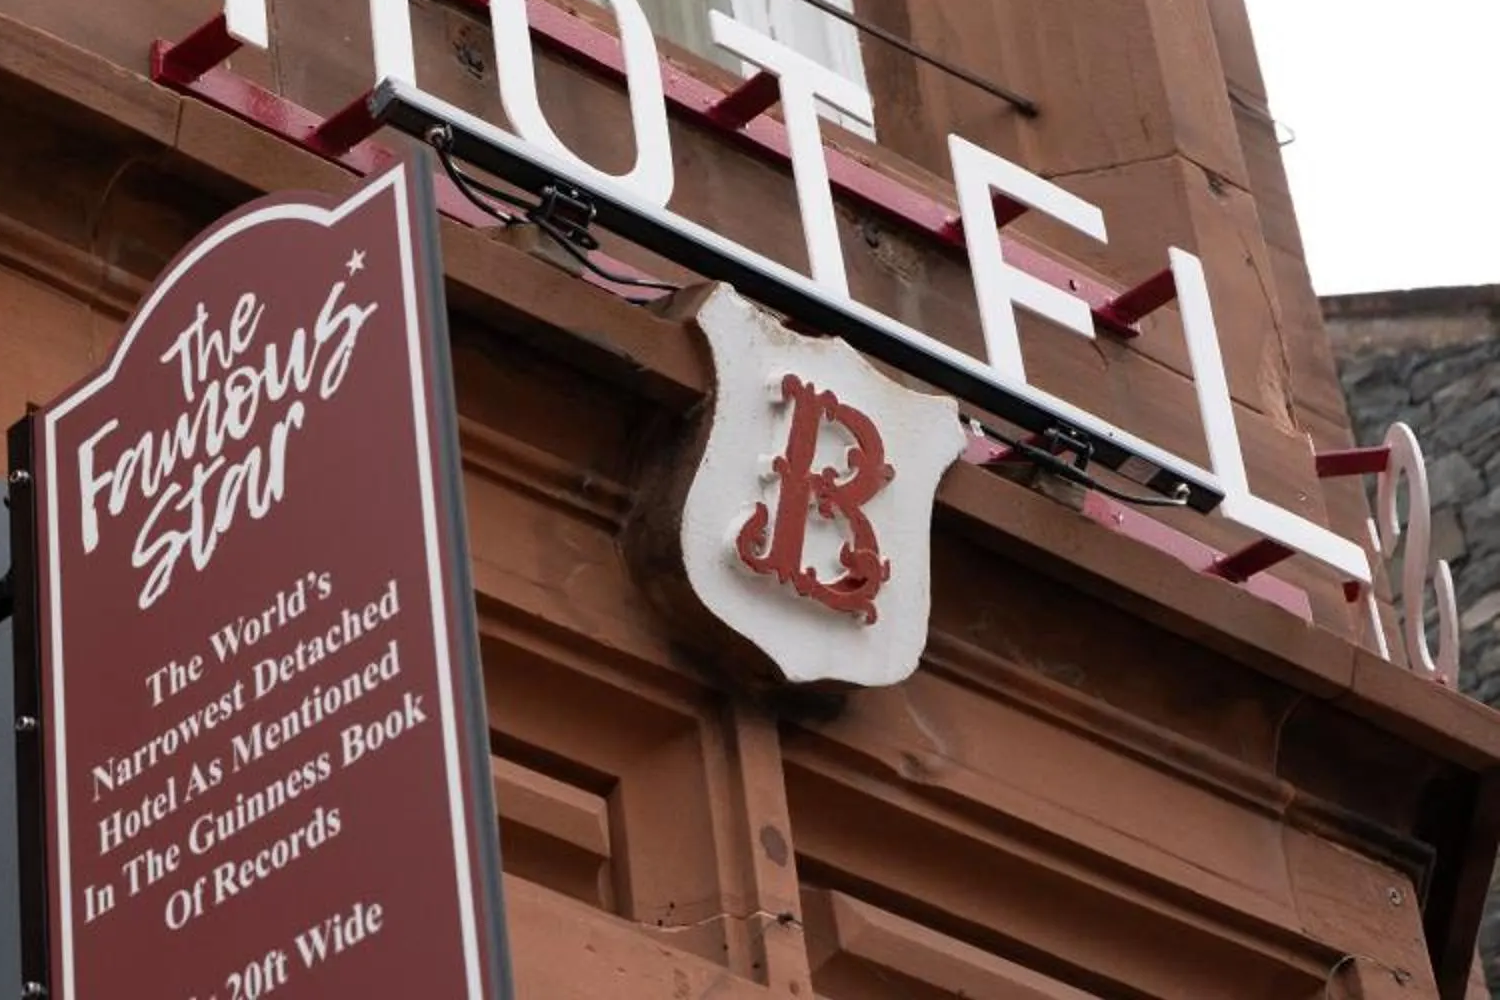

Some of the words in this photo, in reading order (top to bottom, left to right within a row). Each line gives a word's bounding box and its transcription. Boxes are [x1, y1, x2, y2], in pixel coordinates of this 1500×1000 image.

[78, 282, 378, 554] Famous
[160, 293, 265, 402] The
[131, 401, 304, 609] Star
[92, 680, 245, 801] Narrowest
[252, 579, 400, 699] Detached
[145, 655, 203, 706] The
[209, 571, 332, 663] World's
[85, 883, 116, 924] In
[122, 845, 180, 896] The
[188, 752, 331, 856] Guinness
[340, 692, 427, 768] Book
[99, 777, 177, 854] Hotel
[185, 758, 224, 803] As
[231, 640, 400, 773] Mentioned
[165, 877, 207, 929] Of
[213, 806, 342, 905] Records
[225, 950, 288, 1000] 20ft
[294, 903, 383, 969] Wide
